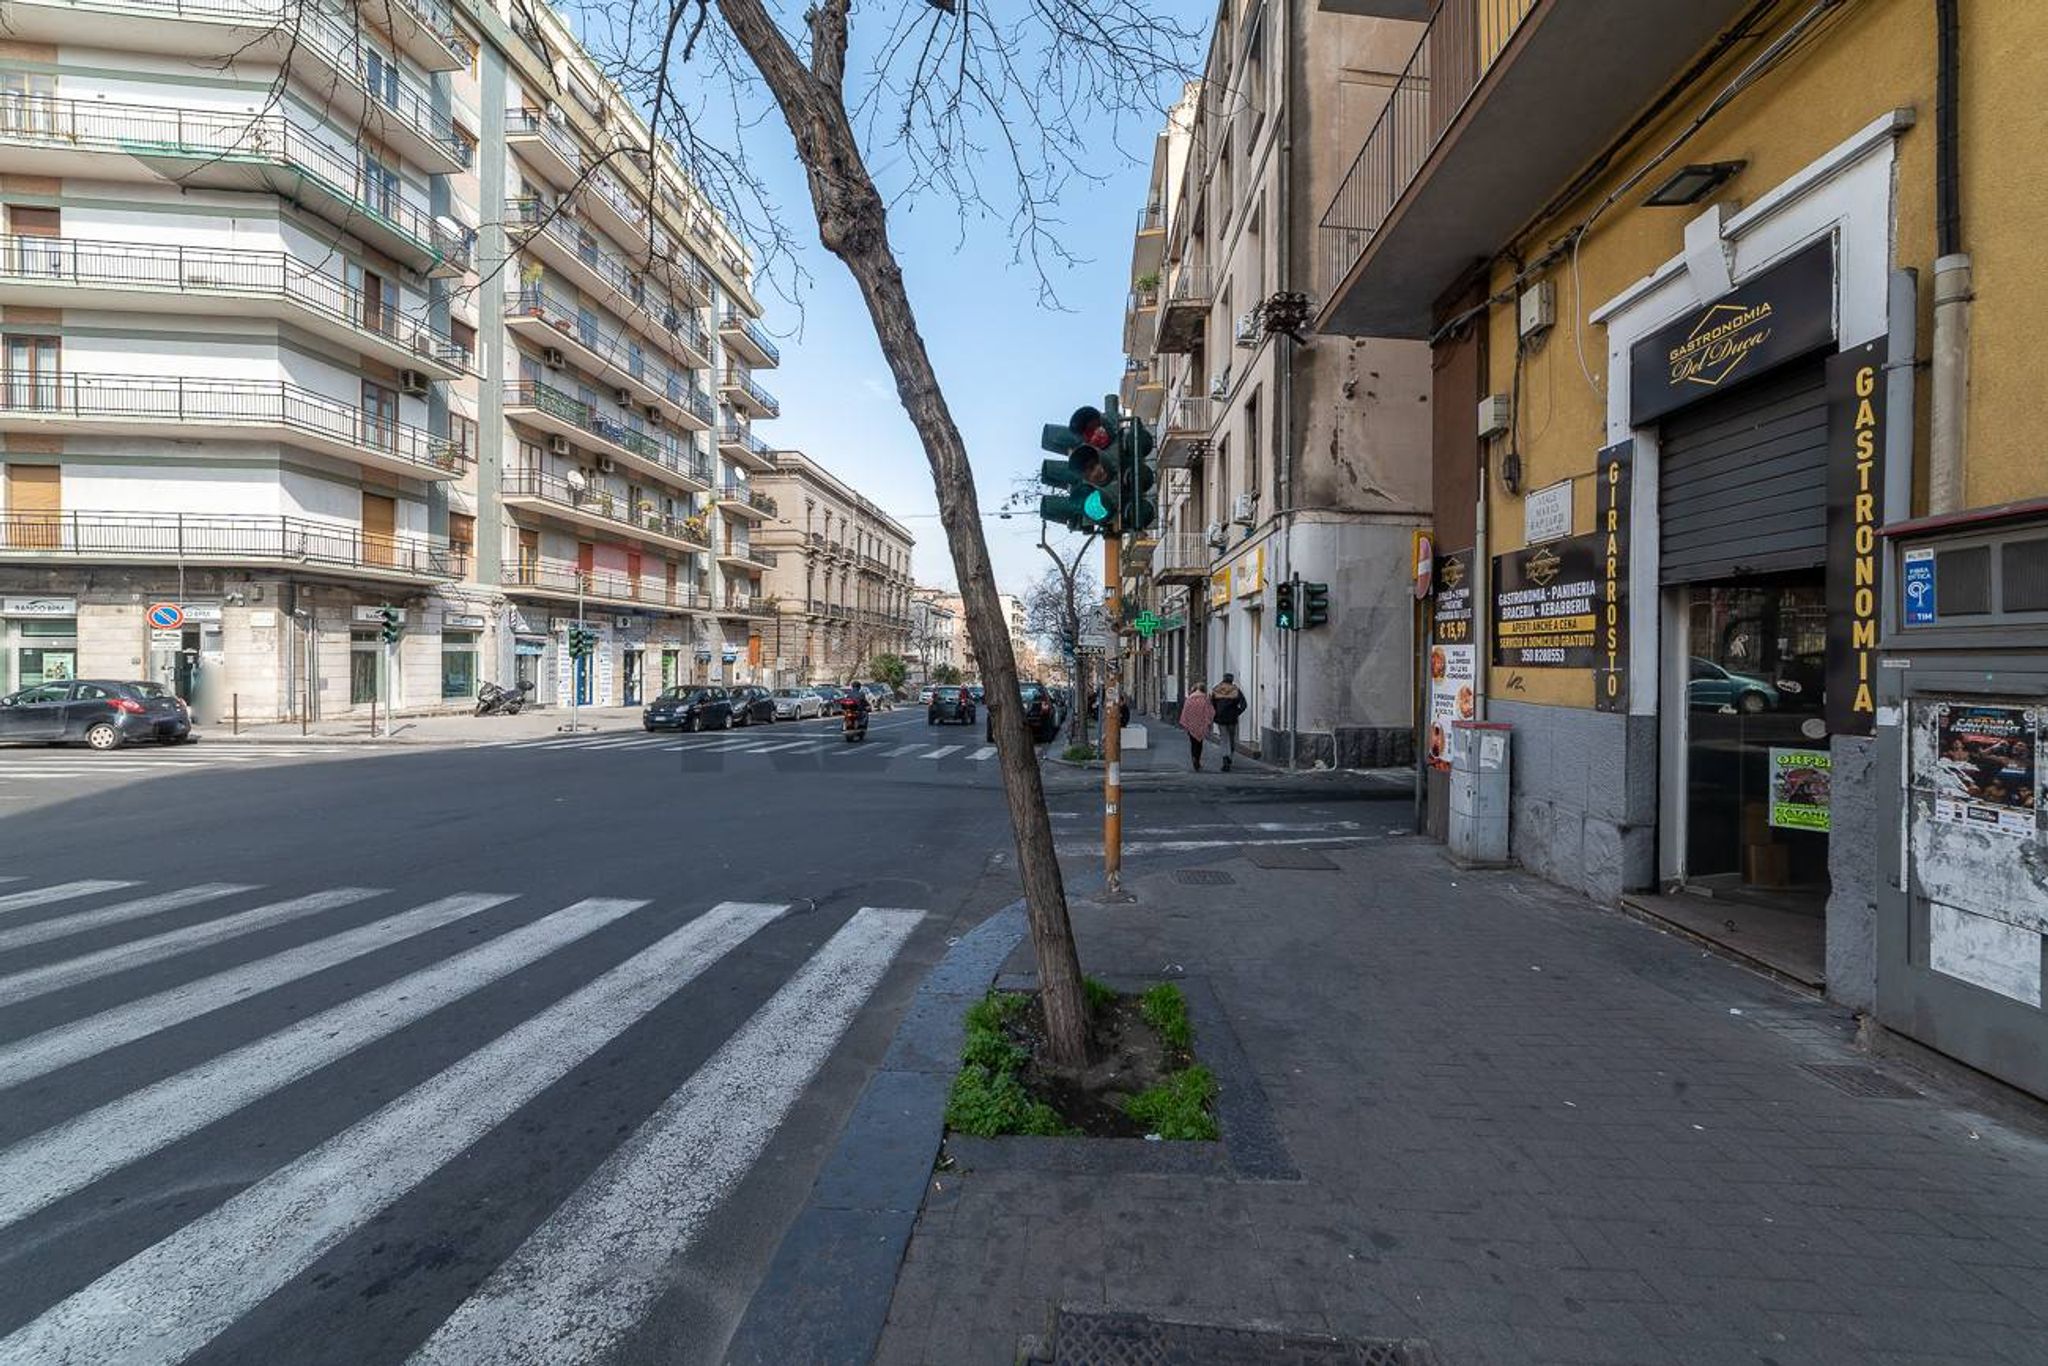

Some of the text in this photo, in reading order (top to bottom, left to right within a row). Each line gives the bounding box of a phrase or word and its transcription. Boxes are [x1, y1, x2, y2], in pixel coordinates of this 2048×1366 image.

[1669, 302, 1772, 361] GASTRONOMIA
[1670, 327, 1772, 385] Del Duca
[1852, 365, 1876, 714] GASTRONOMIA
[1606, 460, 1620, 698] GIRARROSTO
[1498, 580, 1596, 606] GASTRONOMIA PANINERIA
[1502, 598, 1591, 620] BRACERIA KEBABBERIA
[1916, 612, 1933, 621] TIM
[1446, 620, 1467, 641] 15,99
[1512, 622, 1532, 633] APERTI
[1533, 620, 1553, 632] ANCHE
[1560, 618, 1578, 630] CENA
[1499, 637, 1523, 649] SERVIZIO
[1529, 636, 1561, 648] DOMICILIO
[1561, 635, 1595, 647] GRATUITO
